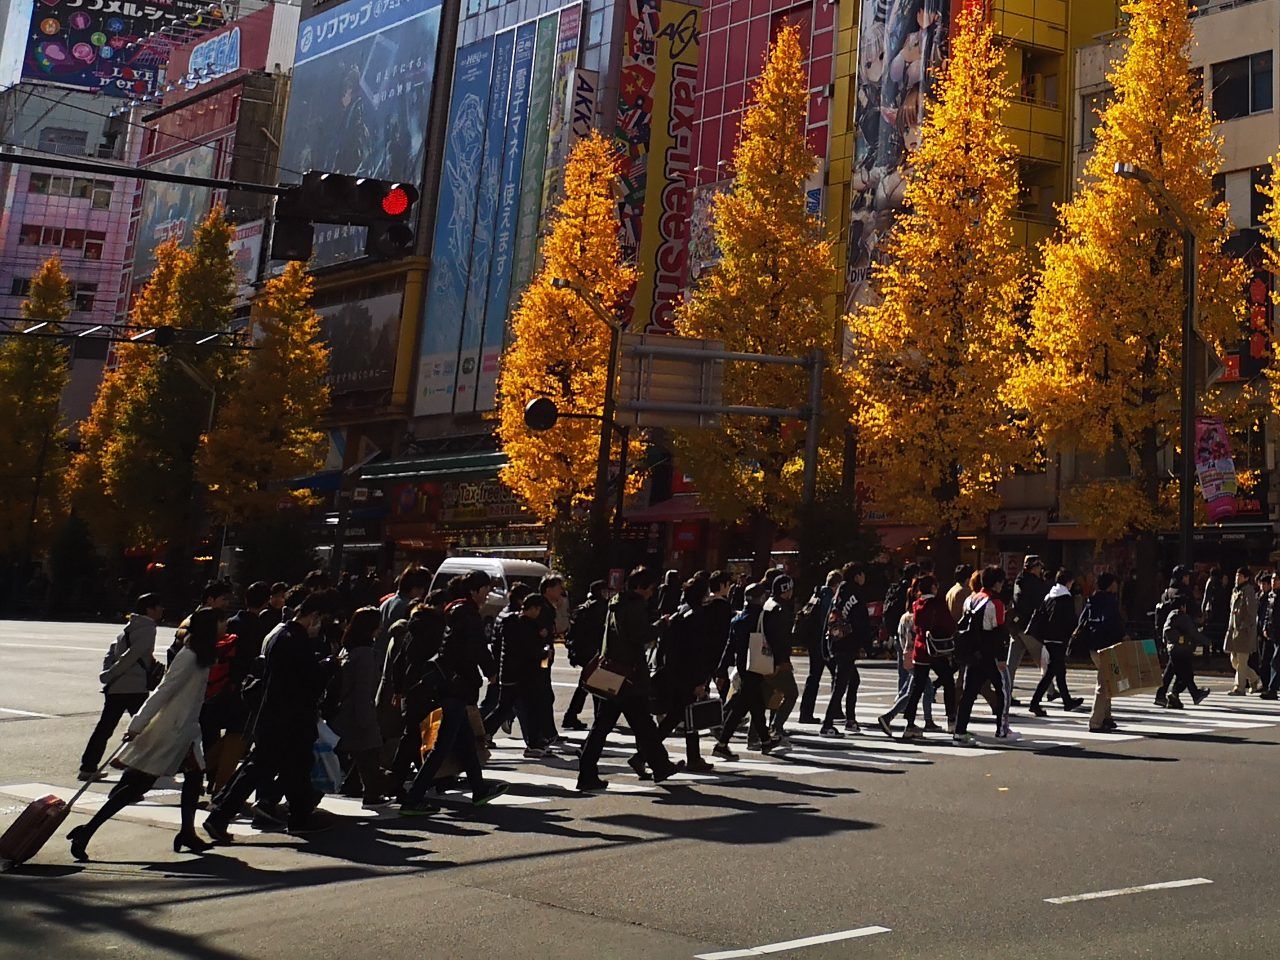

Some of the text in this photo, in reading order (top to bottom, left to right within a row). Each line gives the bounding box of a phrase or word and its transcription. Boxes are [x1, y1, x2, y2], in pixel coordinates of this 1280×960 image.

[317, 1, 372, 43] ソフマップ
